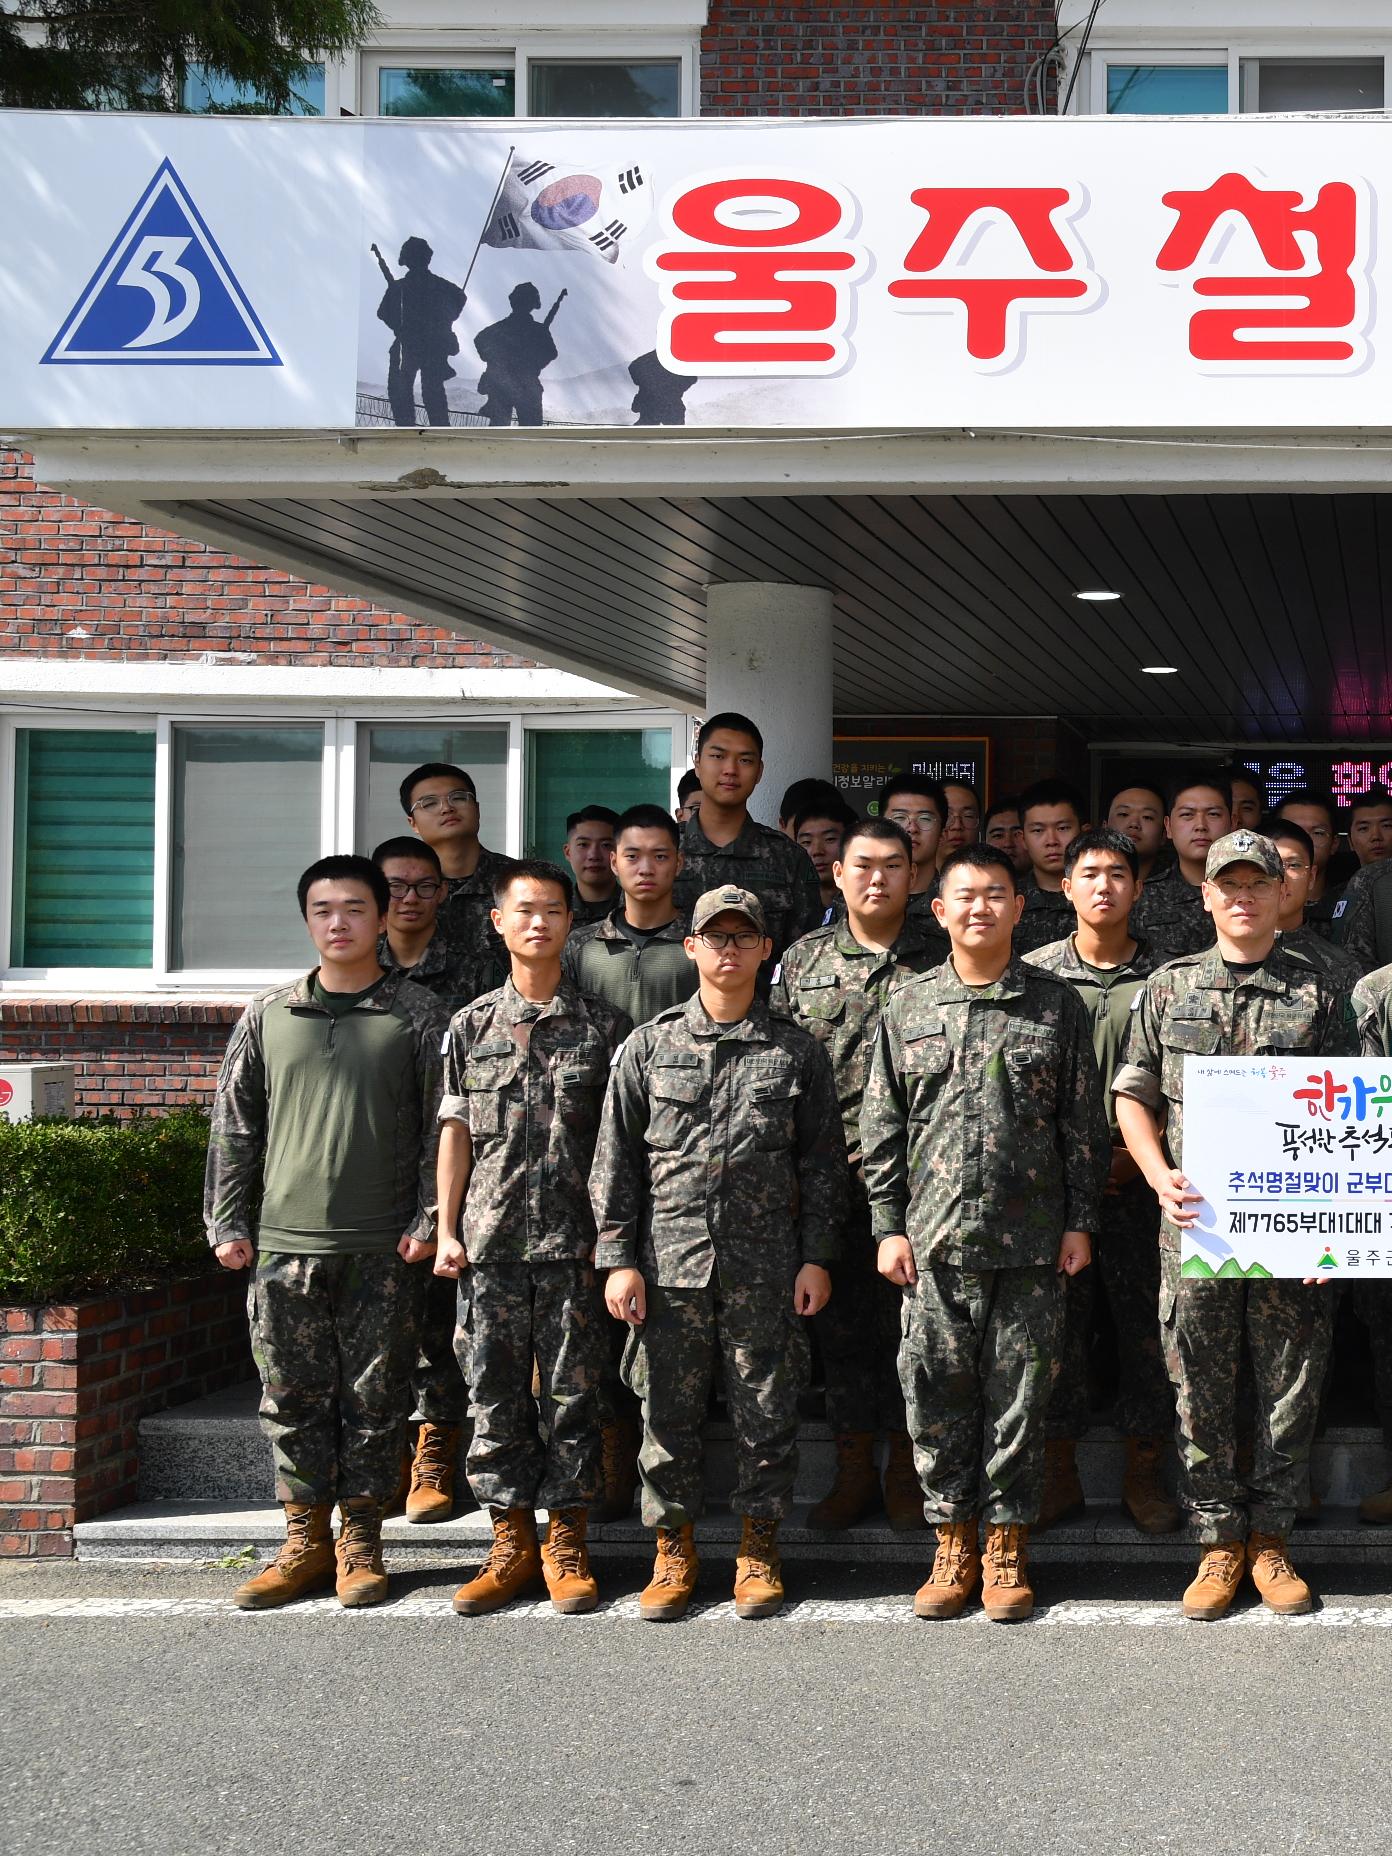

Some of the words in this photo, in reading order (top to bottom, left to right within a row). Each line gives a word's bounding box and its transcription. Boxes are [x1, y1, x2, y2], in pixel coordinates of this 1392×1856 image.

[655, 177, 1089, 363] 울주
[833, 774, 894, 789] 정보알리
[1268, 1064, 1287, 1081] 울주
[1275, 1121, 1337, 1162] 풍성한
[1228, 1170, 1339, 1194] 추석명절맞이
[1229, 1211, 1382, 1234] 제7765부대1대대
